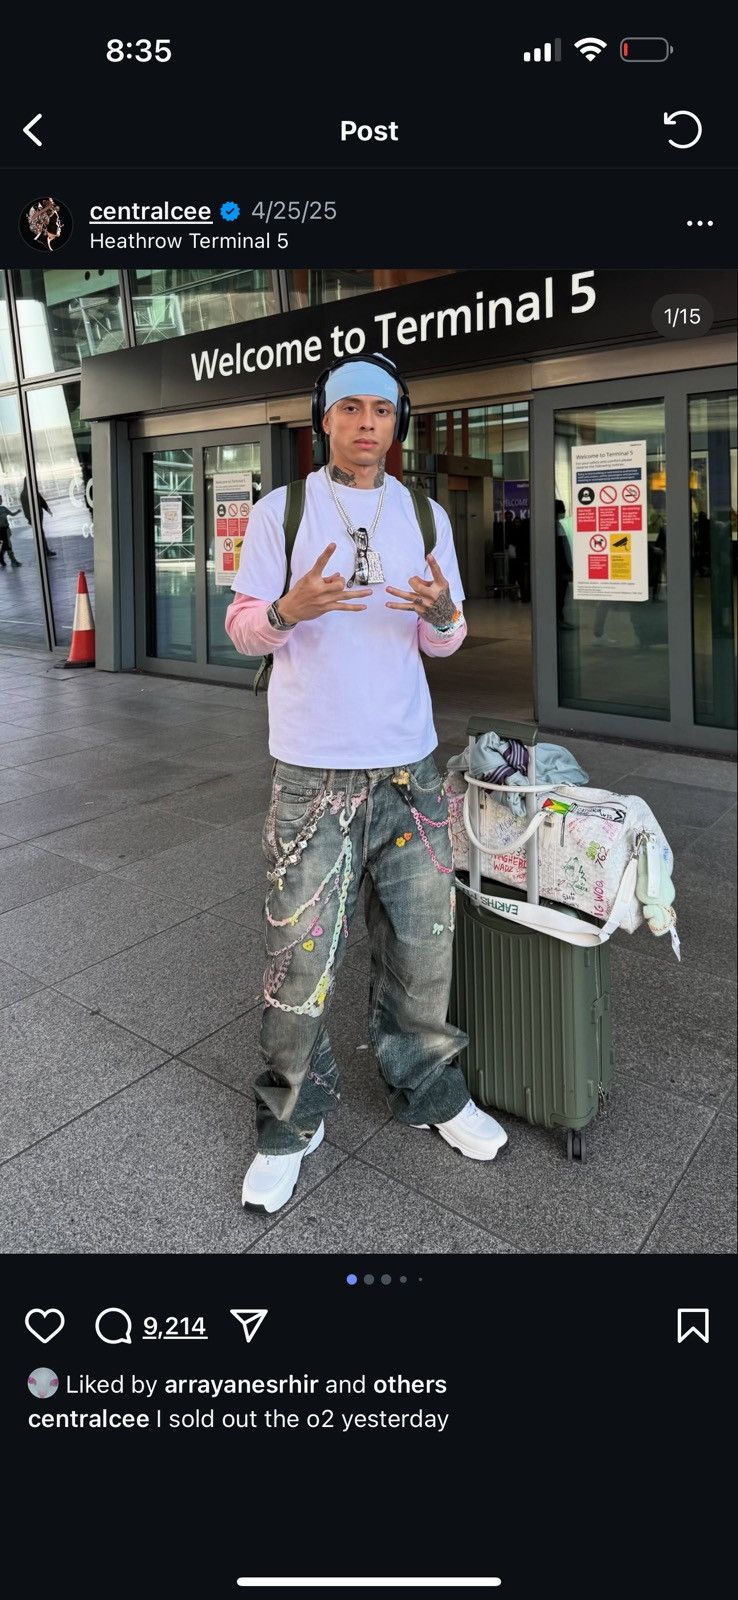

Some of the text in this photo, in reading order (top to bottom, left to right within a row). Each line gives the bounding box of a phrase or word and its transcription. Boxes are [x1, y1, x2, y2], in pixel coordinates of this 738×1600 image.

[190, 269, 597, 382] Welcome to Terminal 5
